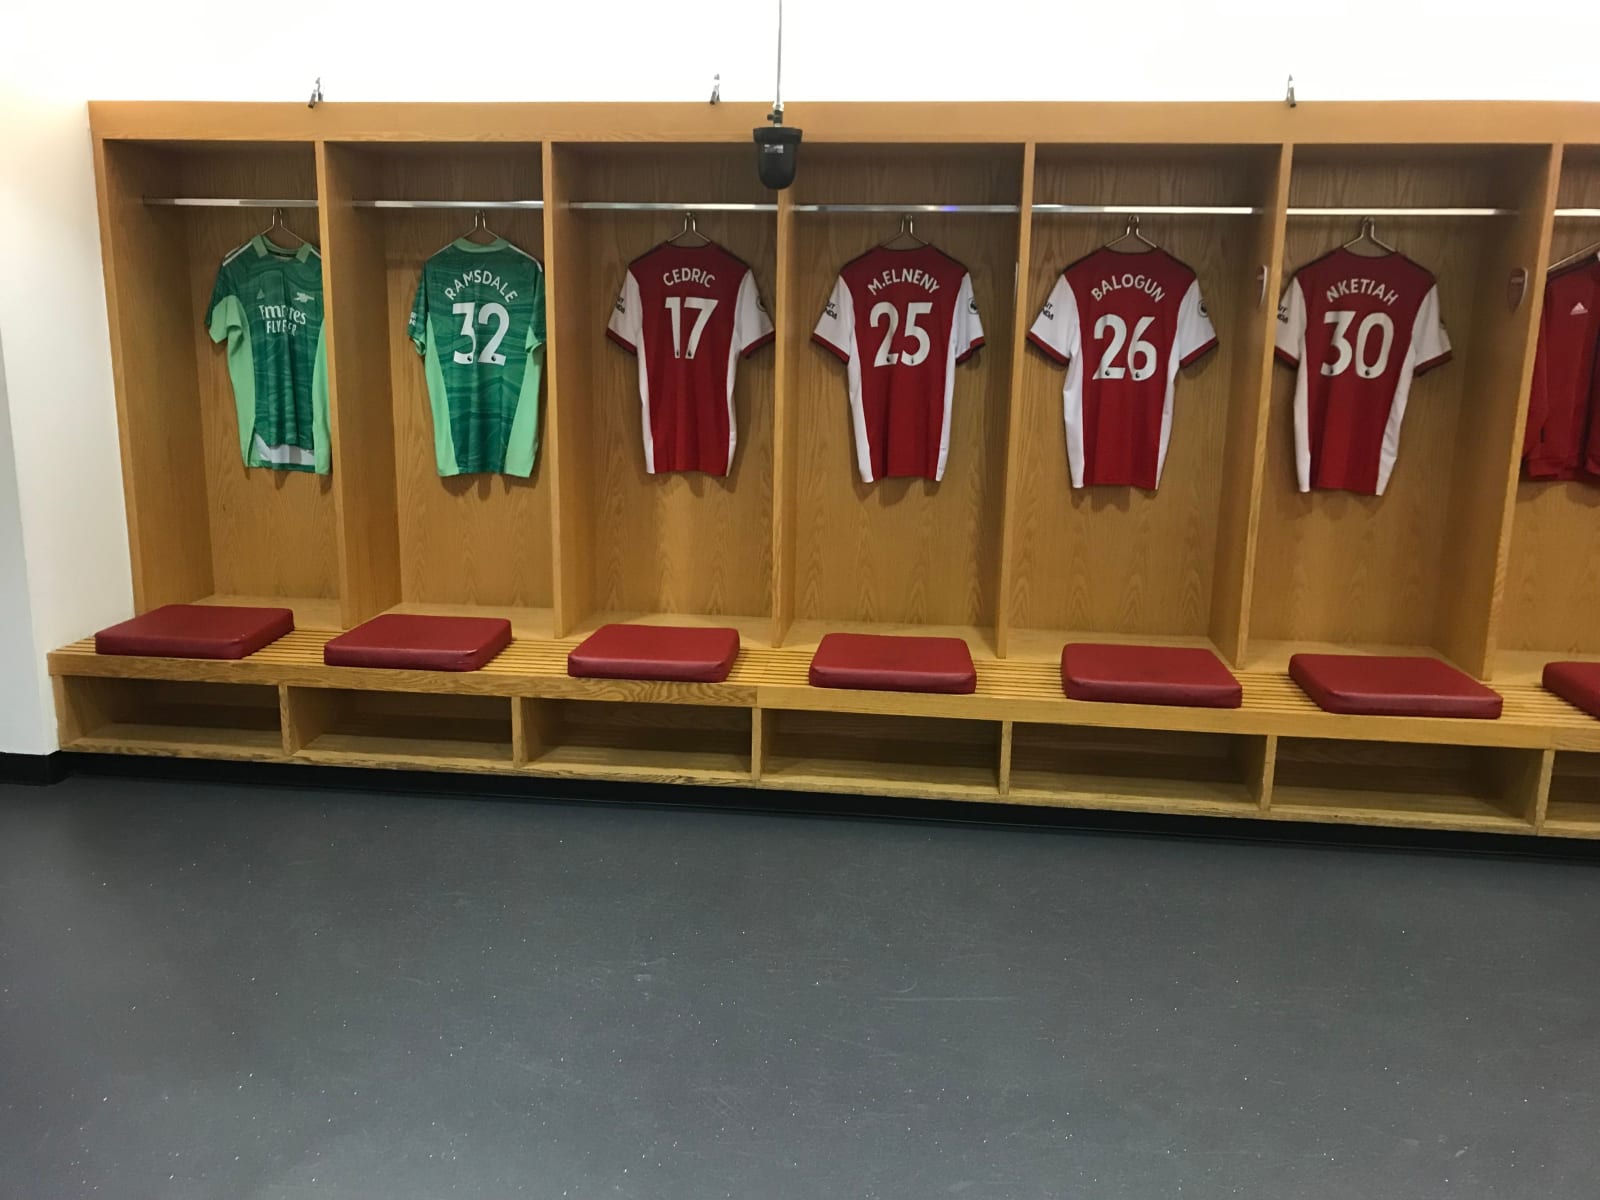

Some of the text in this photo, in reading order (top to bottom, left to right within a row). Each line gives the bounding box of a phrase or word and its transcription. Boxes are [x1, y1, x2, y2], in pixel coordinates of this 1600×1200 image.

[444, 269, 518, 303] RAMSDALE
[663, 267, 716, 288] CEDRIC
[867, 268, 940, 296] M.ELNENY
[1091, 273, 1165, 303] BALOGUN
[1326, 278, 1399, 306] NKETIAH
[452, 302, 510, 366] 32
[664, 296, 719, 360] 17
[869, 301, 933, 368] 25
[1092, 313, 1157, 381] 26
[1320, 310, 1394, 379] 30
